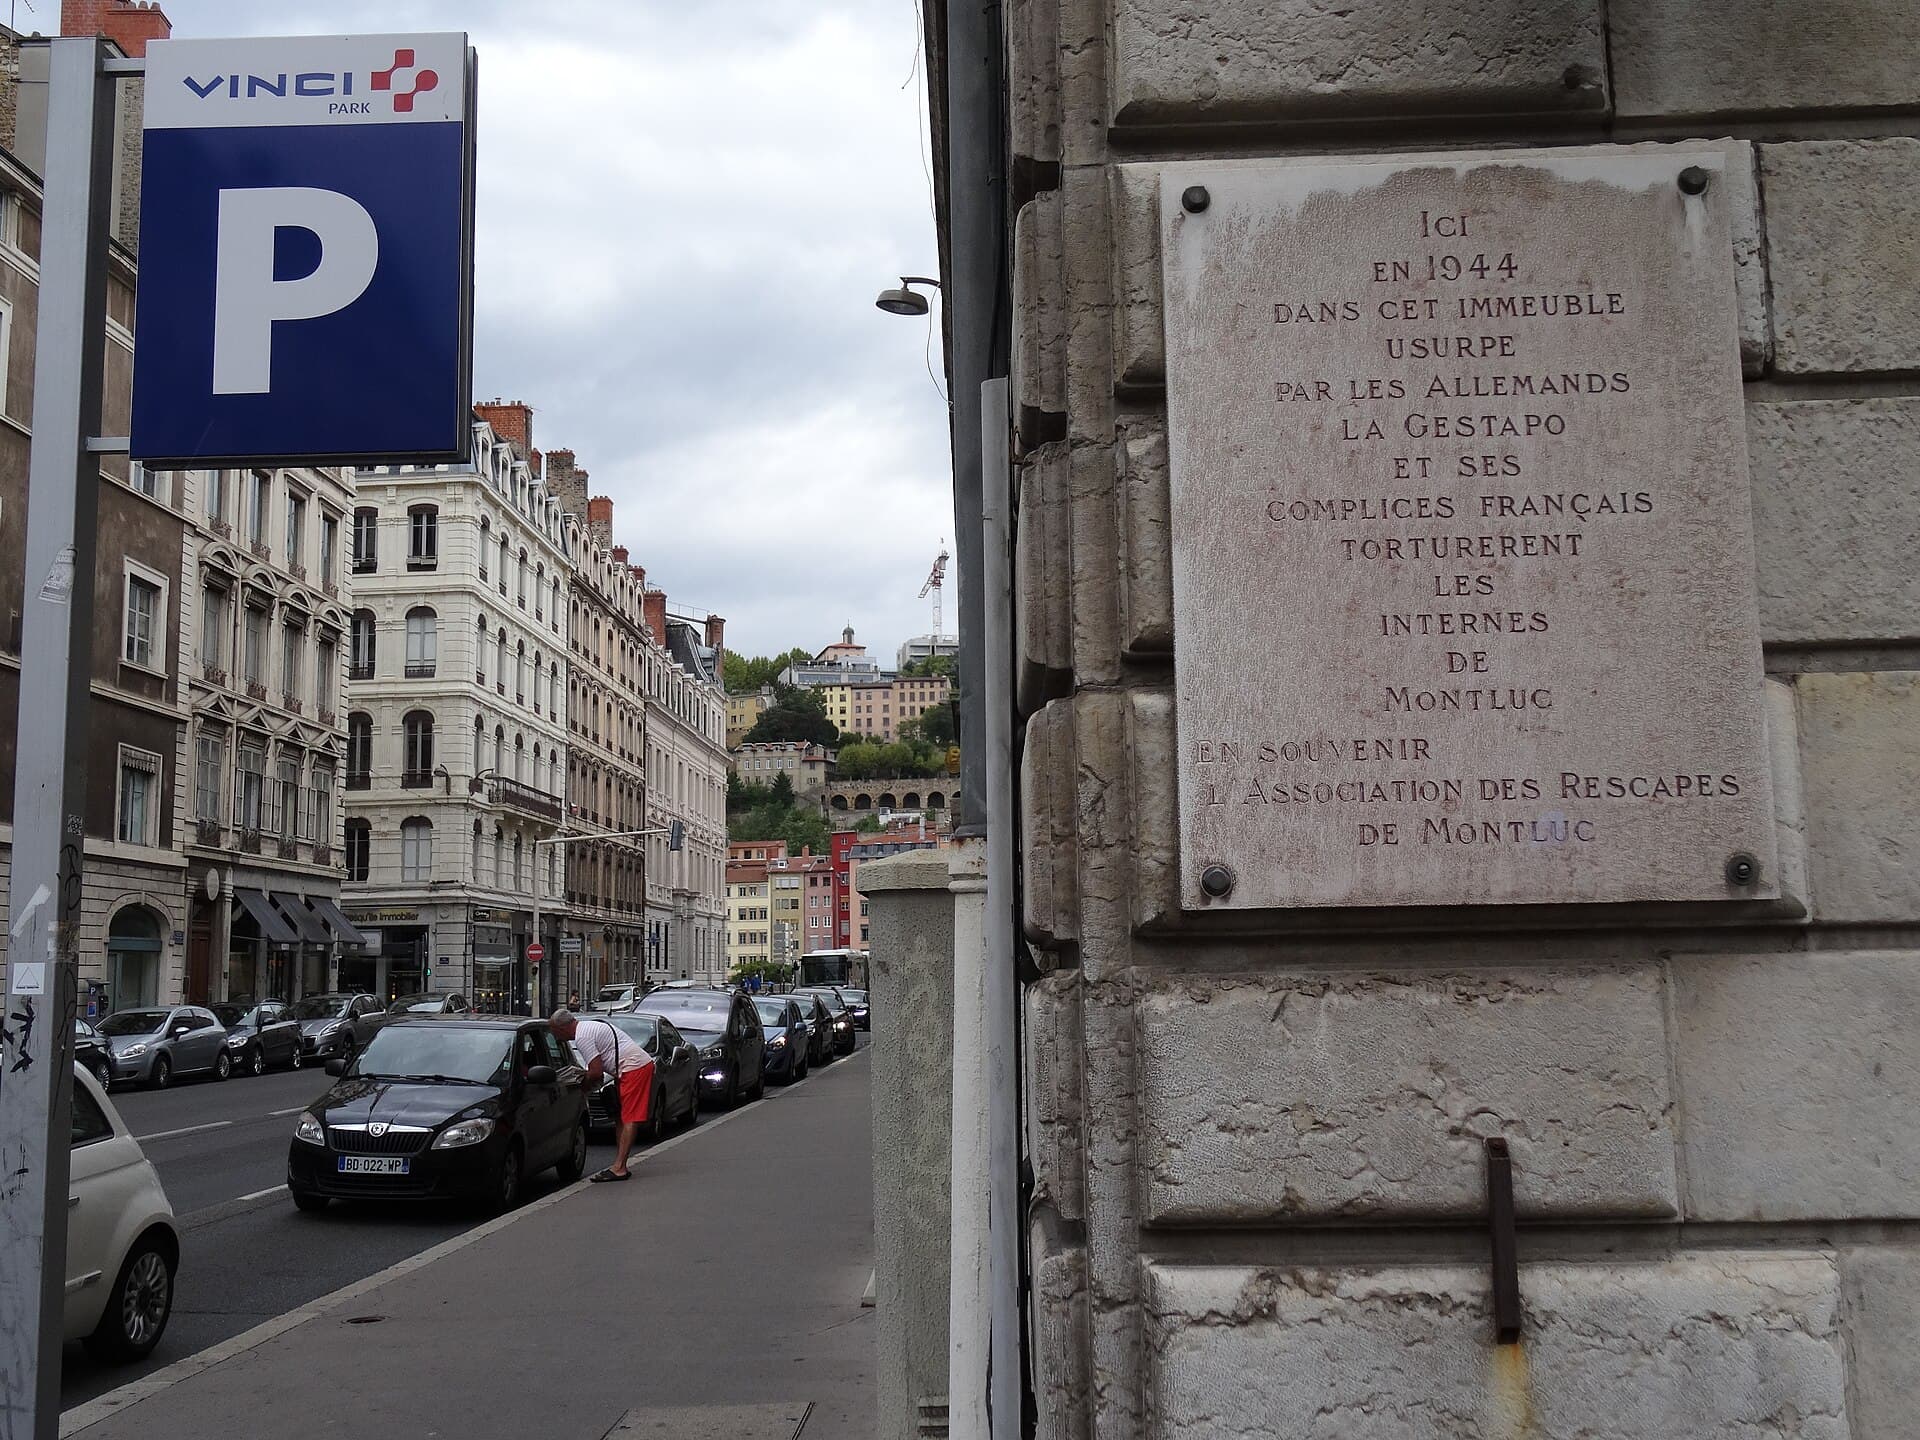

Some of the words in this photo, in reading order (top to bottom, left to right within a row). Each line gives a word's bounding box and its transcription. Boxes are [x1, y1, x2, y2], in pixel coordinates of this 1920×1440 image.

[183, 72, 353, 99] VINCI
[328, 102, 371, 115] PARK
[1373, 261, 1410, 283] EN
[1427, 252, 1519, 282] 1944
[212, 187, 379, 395] P
[1273, 301, 1360, 324] DANS
[1378, 299, 1439, 320] CET
[1458, 293, 1626, 320] IMMEUBLE
[1386, 335, 1517, 360] USURPE
[1276, 380, 1334, 402] PAR
[1350, 378, 1406, 400] LES
[1426, 372, 1631, 399] ALLEMANDS
[1342, 418, 1384, 441] LA
[1405, 413, 1567, 439] GESTAPO
[1393, 457, 1432, 480] ET
[1459, 455, 1522, 477] SES
[1267, 497, 1455, 522] COMPLICES
[1480, 492, 1654, 523] FRANÇAIS
[1342, 534, 1583, 562] TORTURERENT
[1434, 574, 1495, 597] LES
[1382, 611, 1550, 637] INTERNES
[1447, 651, 1489, 674] DE
[1384, 687, 1553, 712] MONTLUC
[1195, 741, 1240, 764] EN
[1259, 738, 1432, 764] SOUVENIR
[1480, 778, 1540, 801] DES
[1561, 771, 1741, 799] RESCAPES
[1359, 823, 1399, 846] DE
[1422, 818, 1596, 846] MONTLUC
